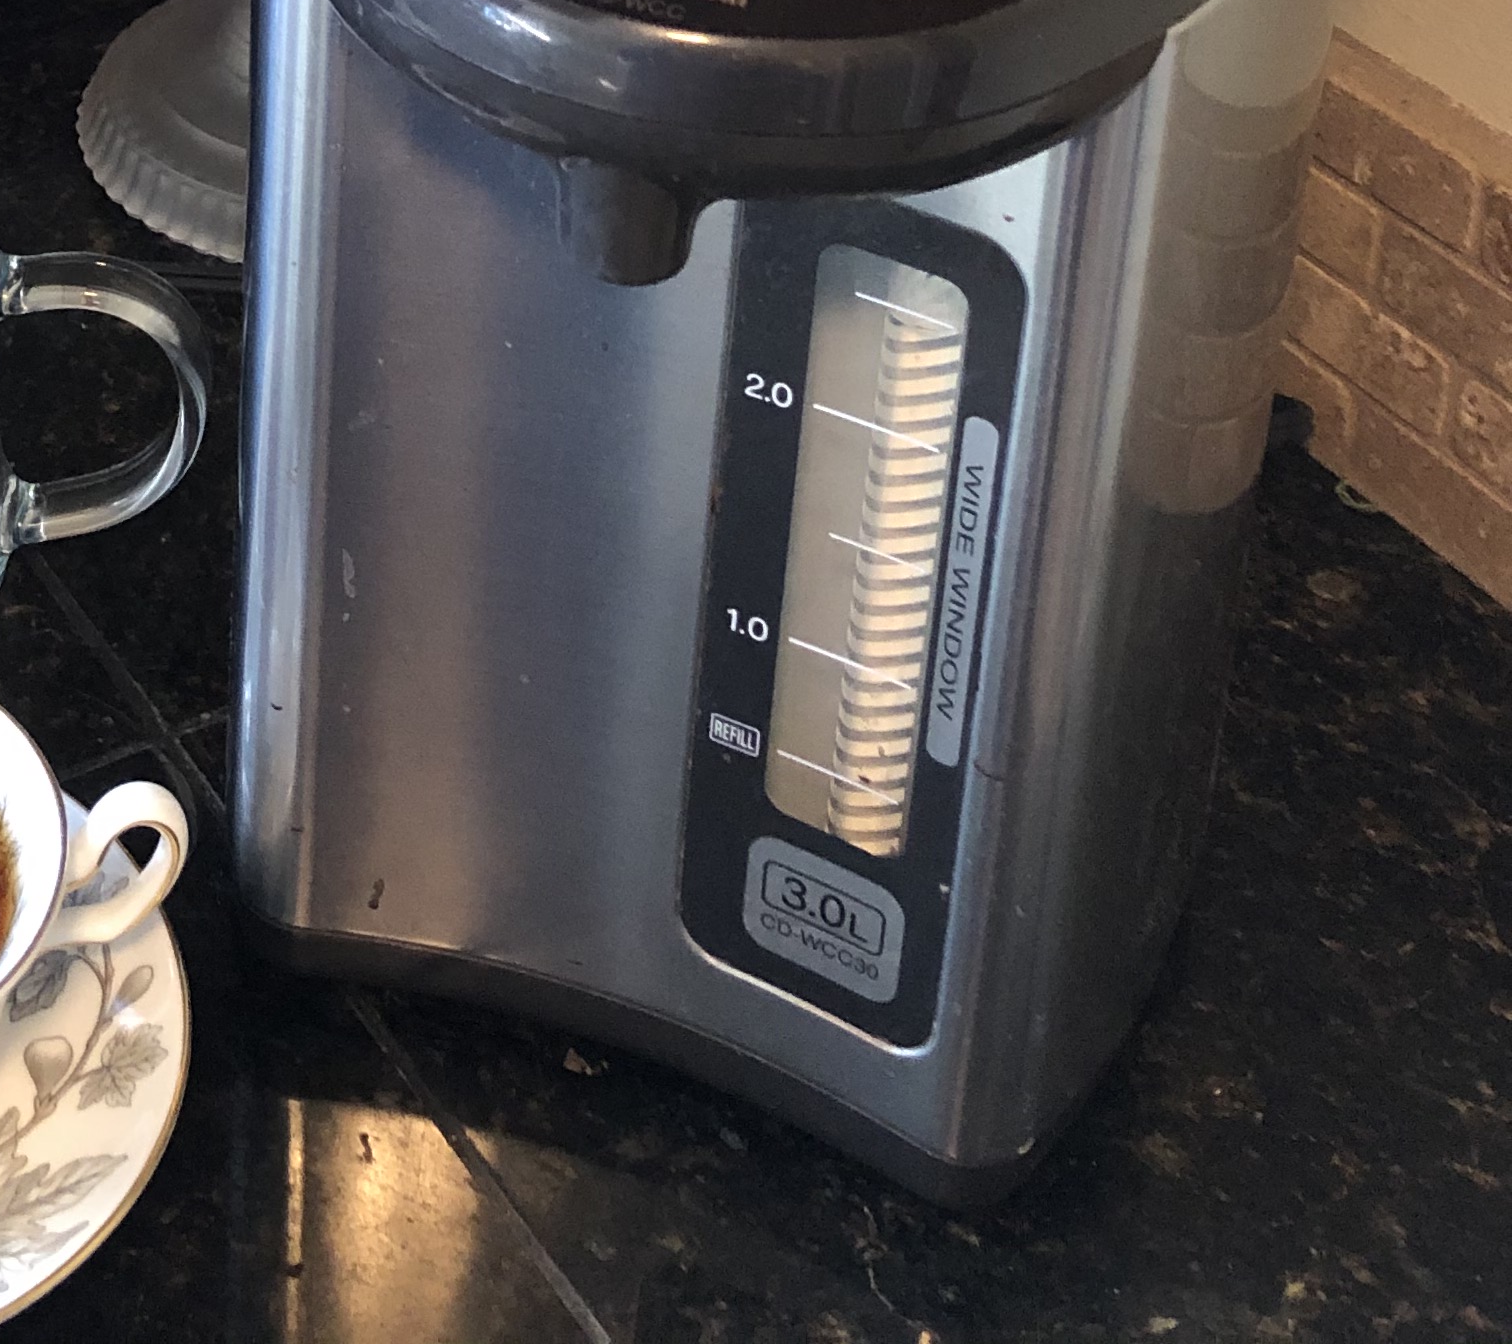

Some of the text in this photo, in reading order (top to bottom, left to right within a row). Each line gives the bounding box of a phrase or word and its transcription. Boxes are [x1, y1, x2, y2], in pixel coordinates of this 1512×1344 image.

[744, 372, 794, 410] 2.0
[935, 463, 985, 724] WIDE WINDOW
[725, 606, 769, 644] 1.0
[714, 719, 755, 750] REFILL
[782, 875, 867, 945] 3.0L
[760, 912, 880, 981] CD-WCC30
